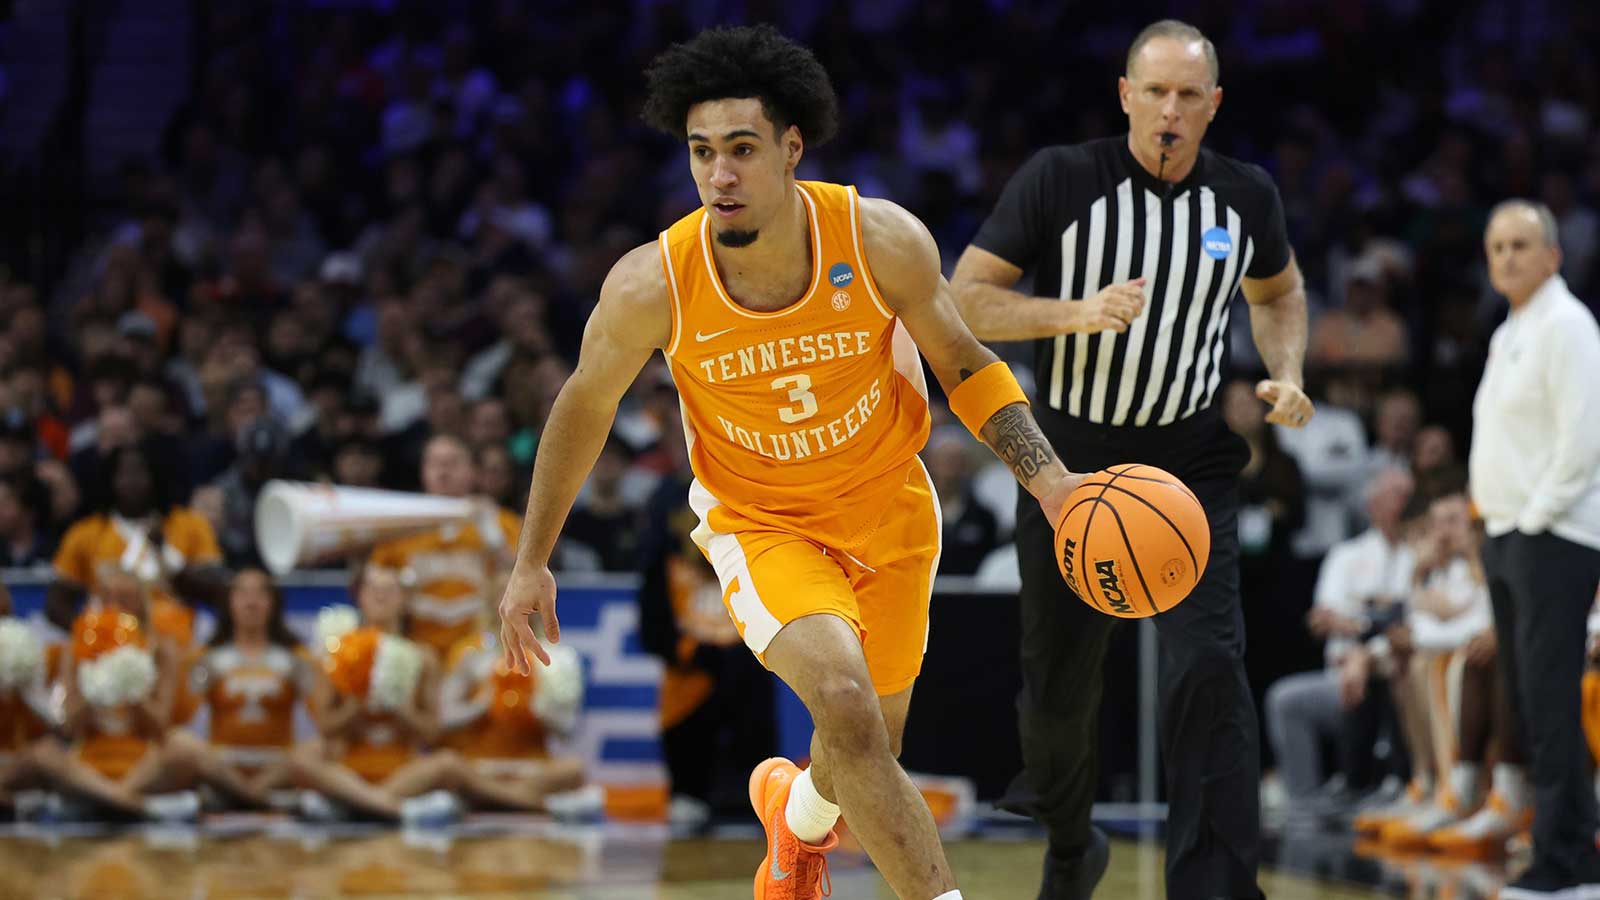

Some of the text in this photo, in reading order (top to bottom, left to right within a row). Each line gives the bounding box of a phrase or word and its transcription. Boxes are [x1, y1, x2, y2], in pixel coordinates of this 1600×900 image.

[832, 293, 849, 310] SEC
[833, 272, 853, 284] NCAA
[700, 331, 871, 384] TENNESSEE
[717, 378, 881, 461] VOLUNTEERS
[770, 373, 819, 424] 3
[1014, 447, 1050, 485] 704
[1095, 560, 1136, 613] NCAA
